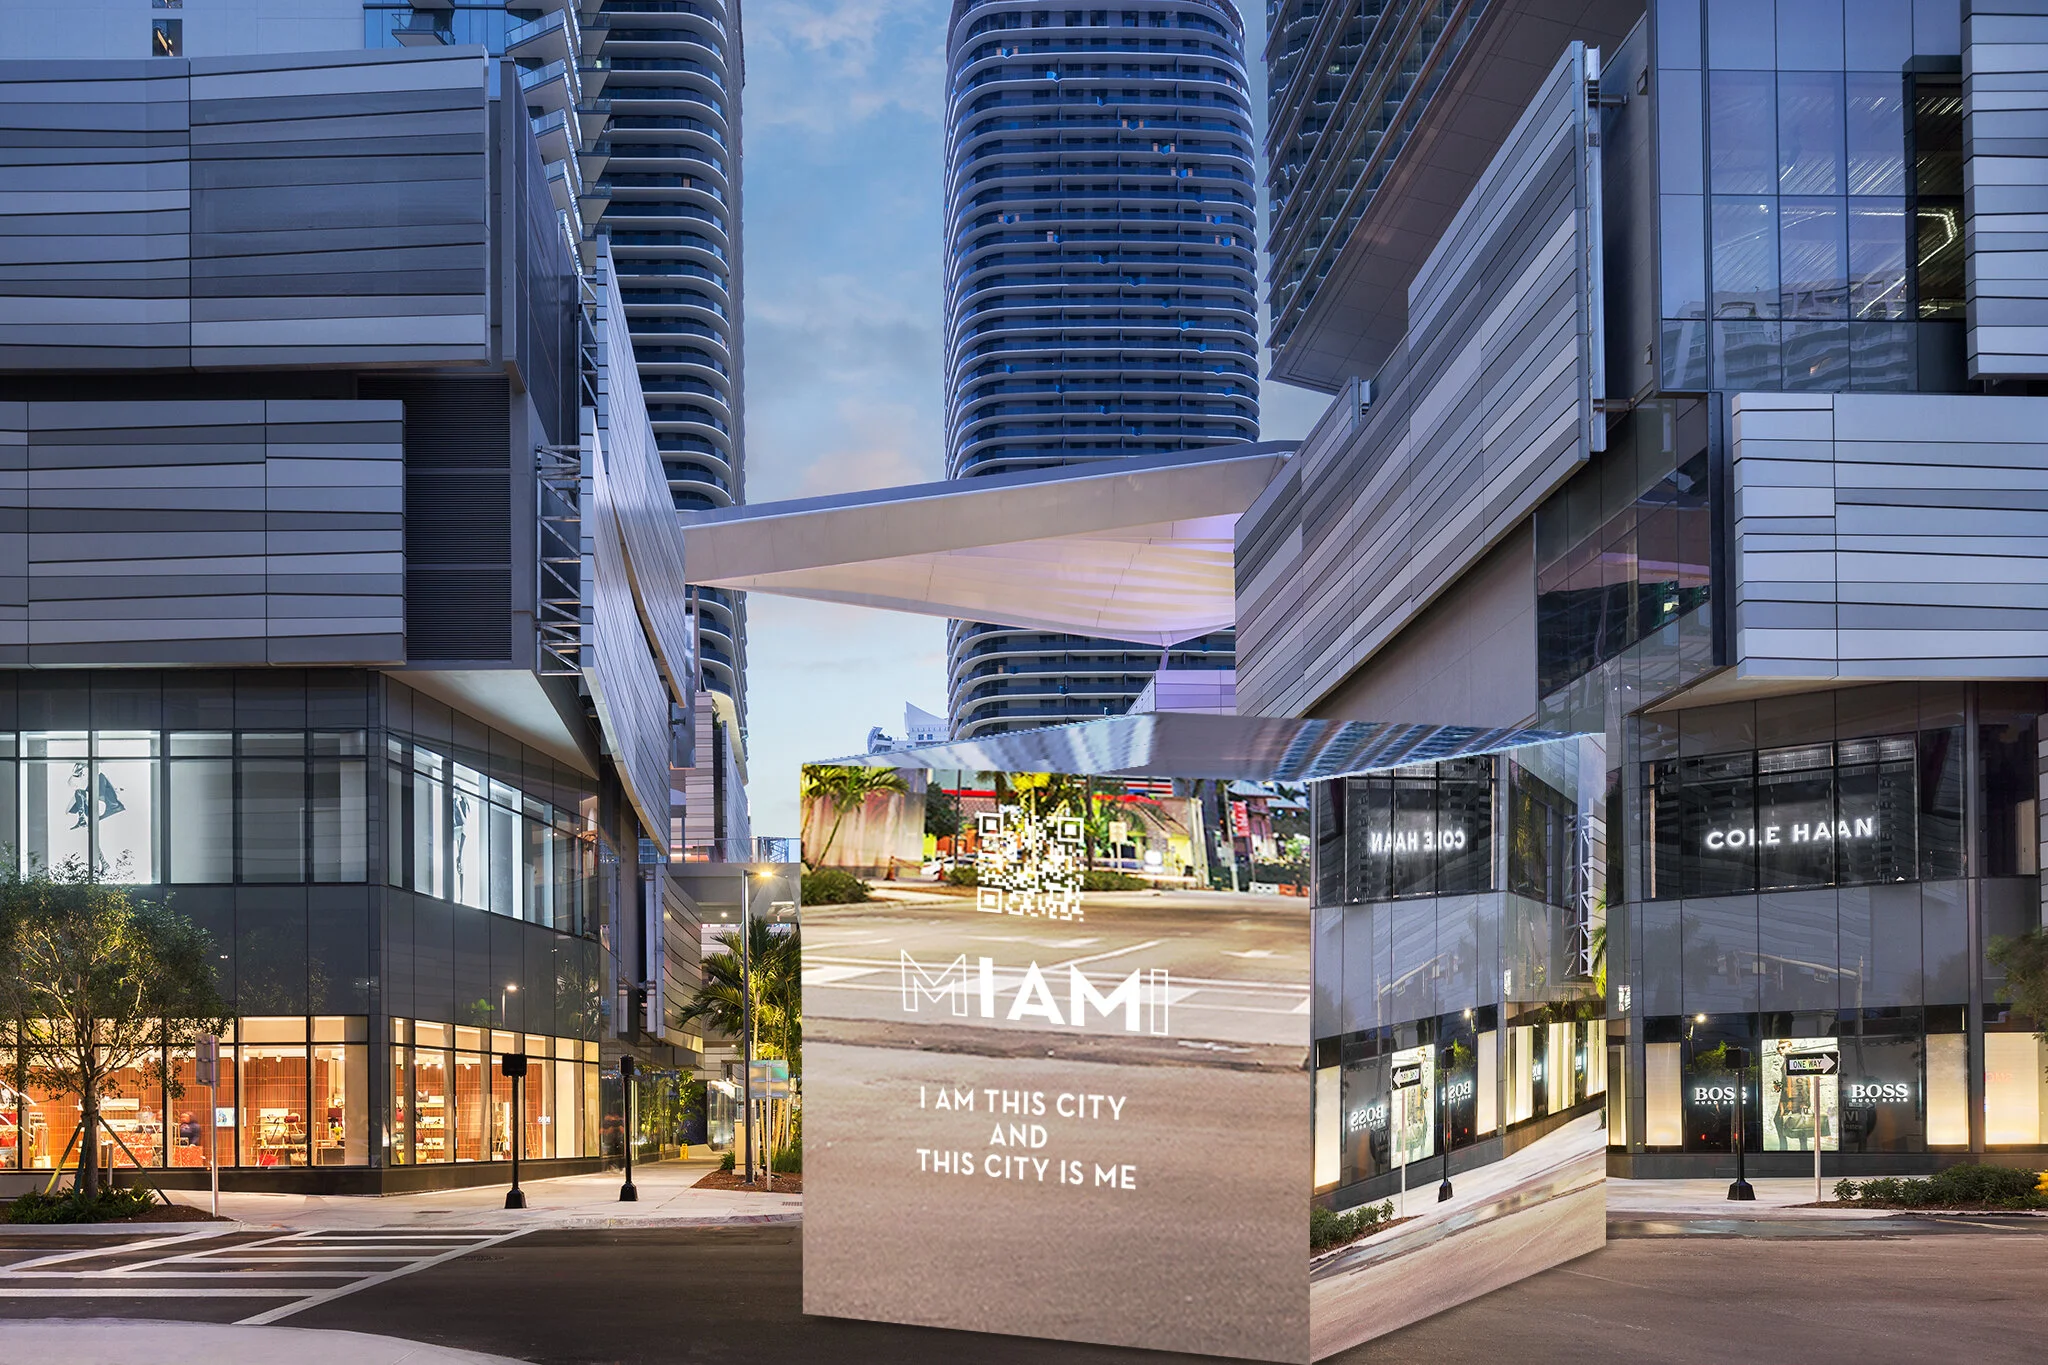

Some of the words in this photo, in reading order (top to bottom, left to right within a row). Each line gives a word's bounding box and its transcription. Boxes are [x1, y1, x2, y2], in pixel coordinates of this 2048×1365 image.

[1706, 826, 1781, 849] COLE
[1792, 817, 1873, 843] HAAN
[900, 948, 1169, 1036] MIAMI
[1793, 1060, 1806, 1069] ONE
[1808, 1059, 1822, 1068] WAY
[920, 1086, 925, 1108] I
[935, 1087, 974, 1111] AM
[984, 1089, 1046, 1115] THIS
[1056, 1093, 1126, 1120] CITY
[1851, 1083, 1909, 1098] BOSS
[989, 1123, 1048, 1148] AND
[916, 1148, 974, 1176] THIS
[984, 1154, 1049, 1182] CITY
[1060, 1159, 1084, 1185] IS
[1095, 1163, 1136, 1190] ME
